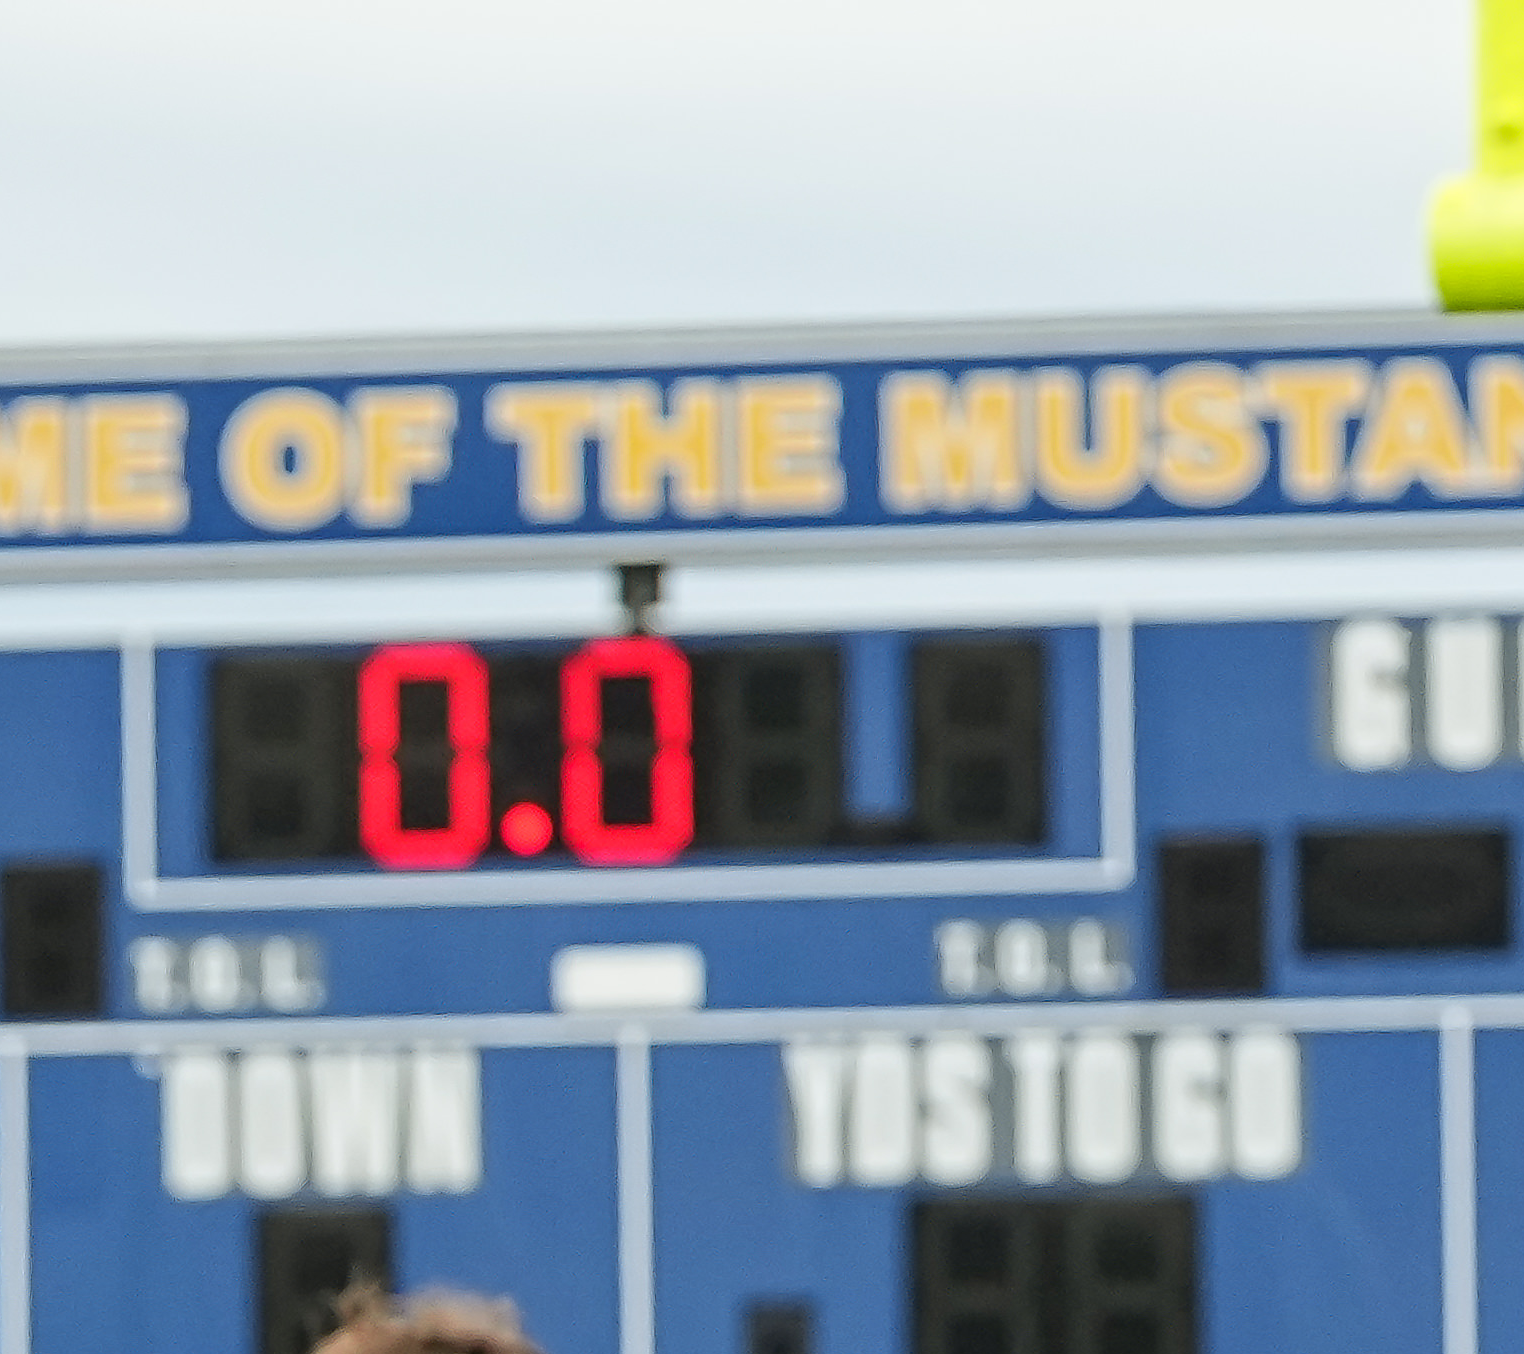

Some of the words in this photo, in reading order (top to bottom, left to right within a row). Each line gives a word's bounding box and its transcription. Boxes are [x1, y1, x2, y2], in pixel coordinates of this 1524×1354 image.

[219, 383, 458, 535] OF
[486, 372, 846, 525] THE
[358, 634, 694, 869] 0.0
[160, 1043, 482, 1202] DOWN
[1153, 1028, 1304, 1183] GO
